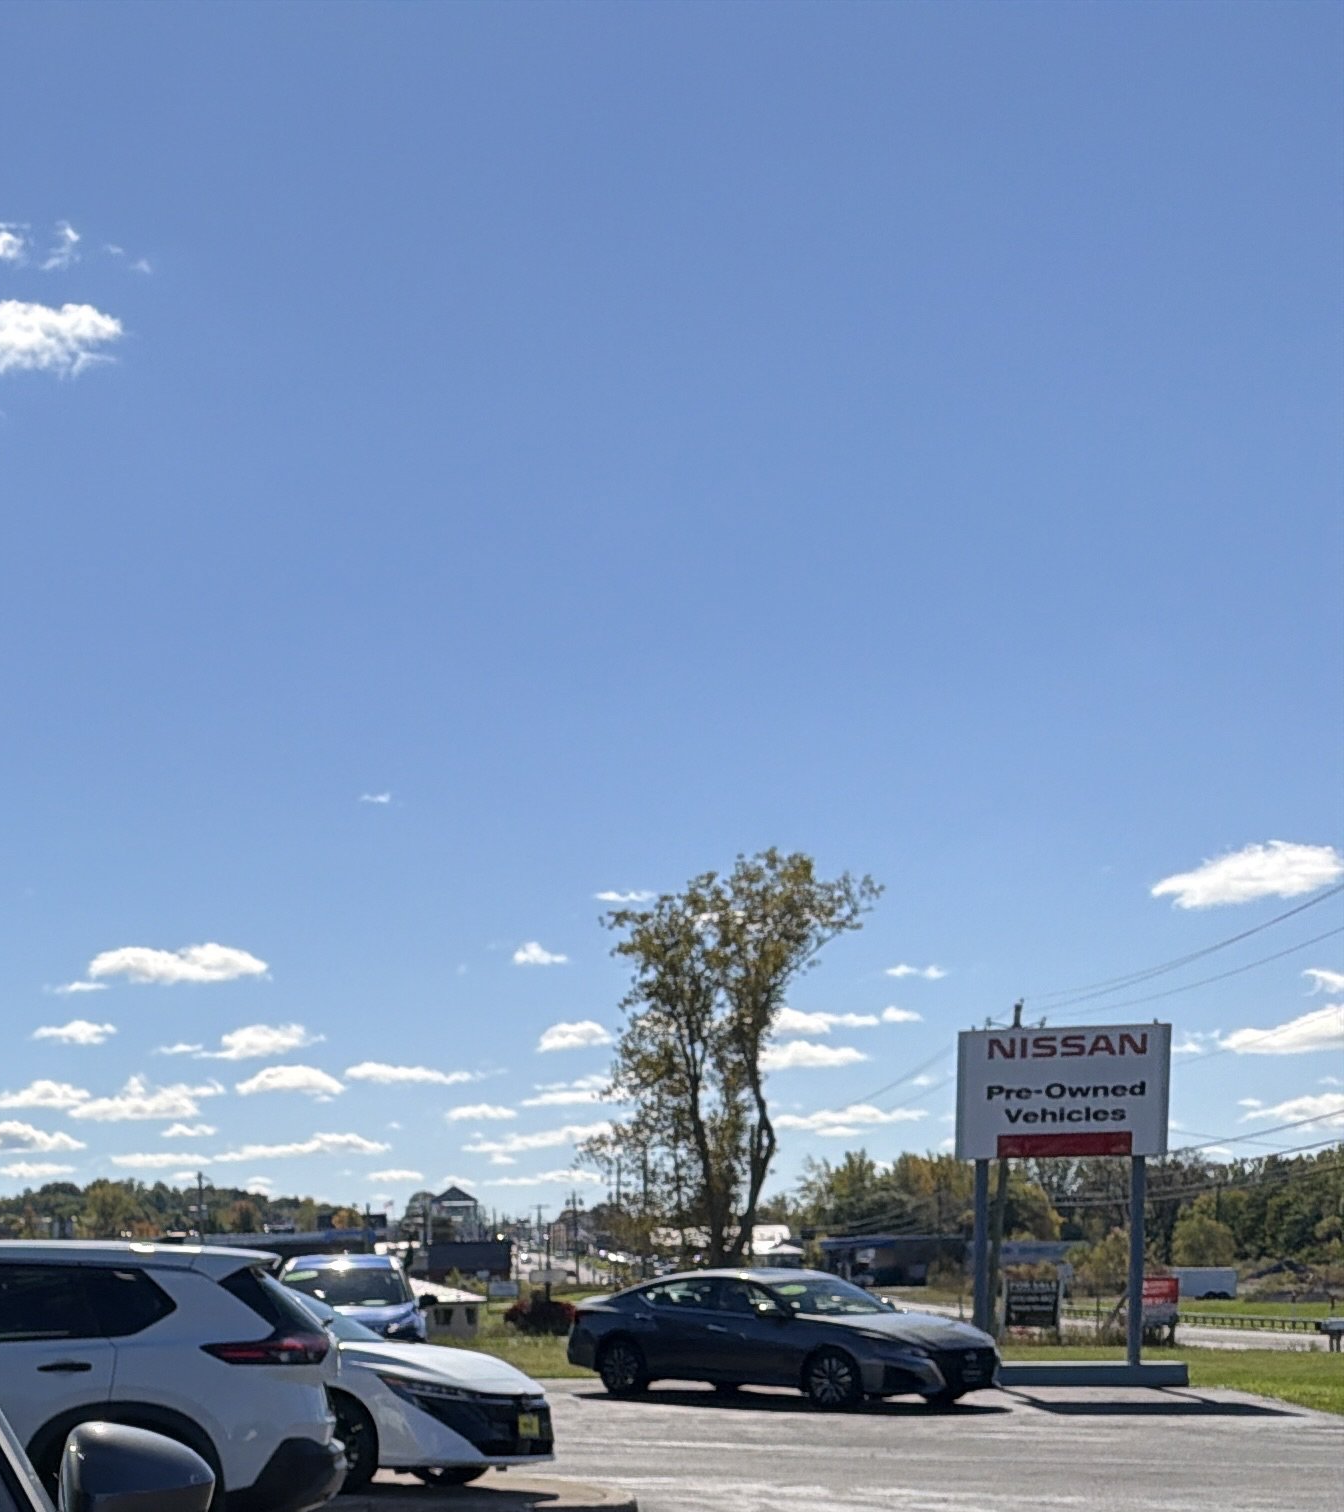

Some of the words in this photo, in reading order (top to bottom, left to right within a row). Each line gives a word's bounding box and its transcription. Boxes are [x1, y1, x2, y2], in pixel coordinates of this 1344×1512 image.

[987, 1032, 1148, 1061] NISSAN
[986, 1080, 1146, 1101] Pre-Owned
[1005, 1106, 1127, 1124] Vehicles
